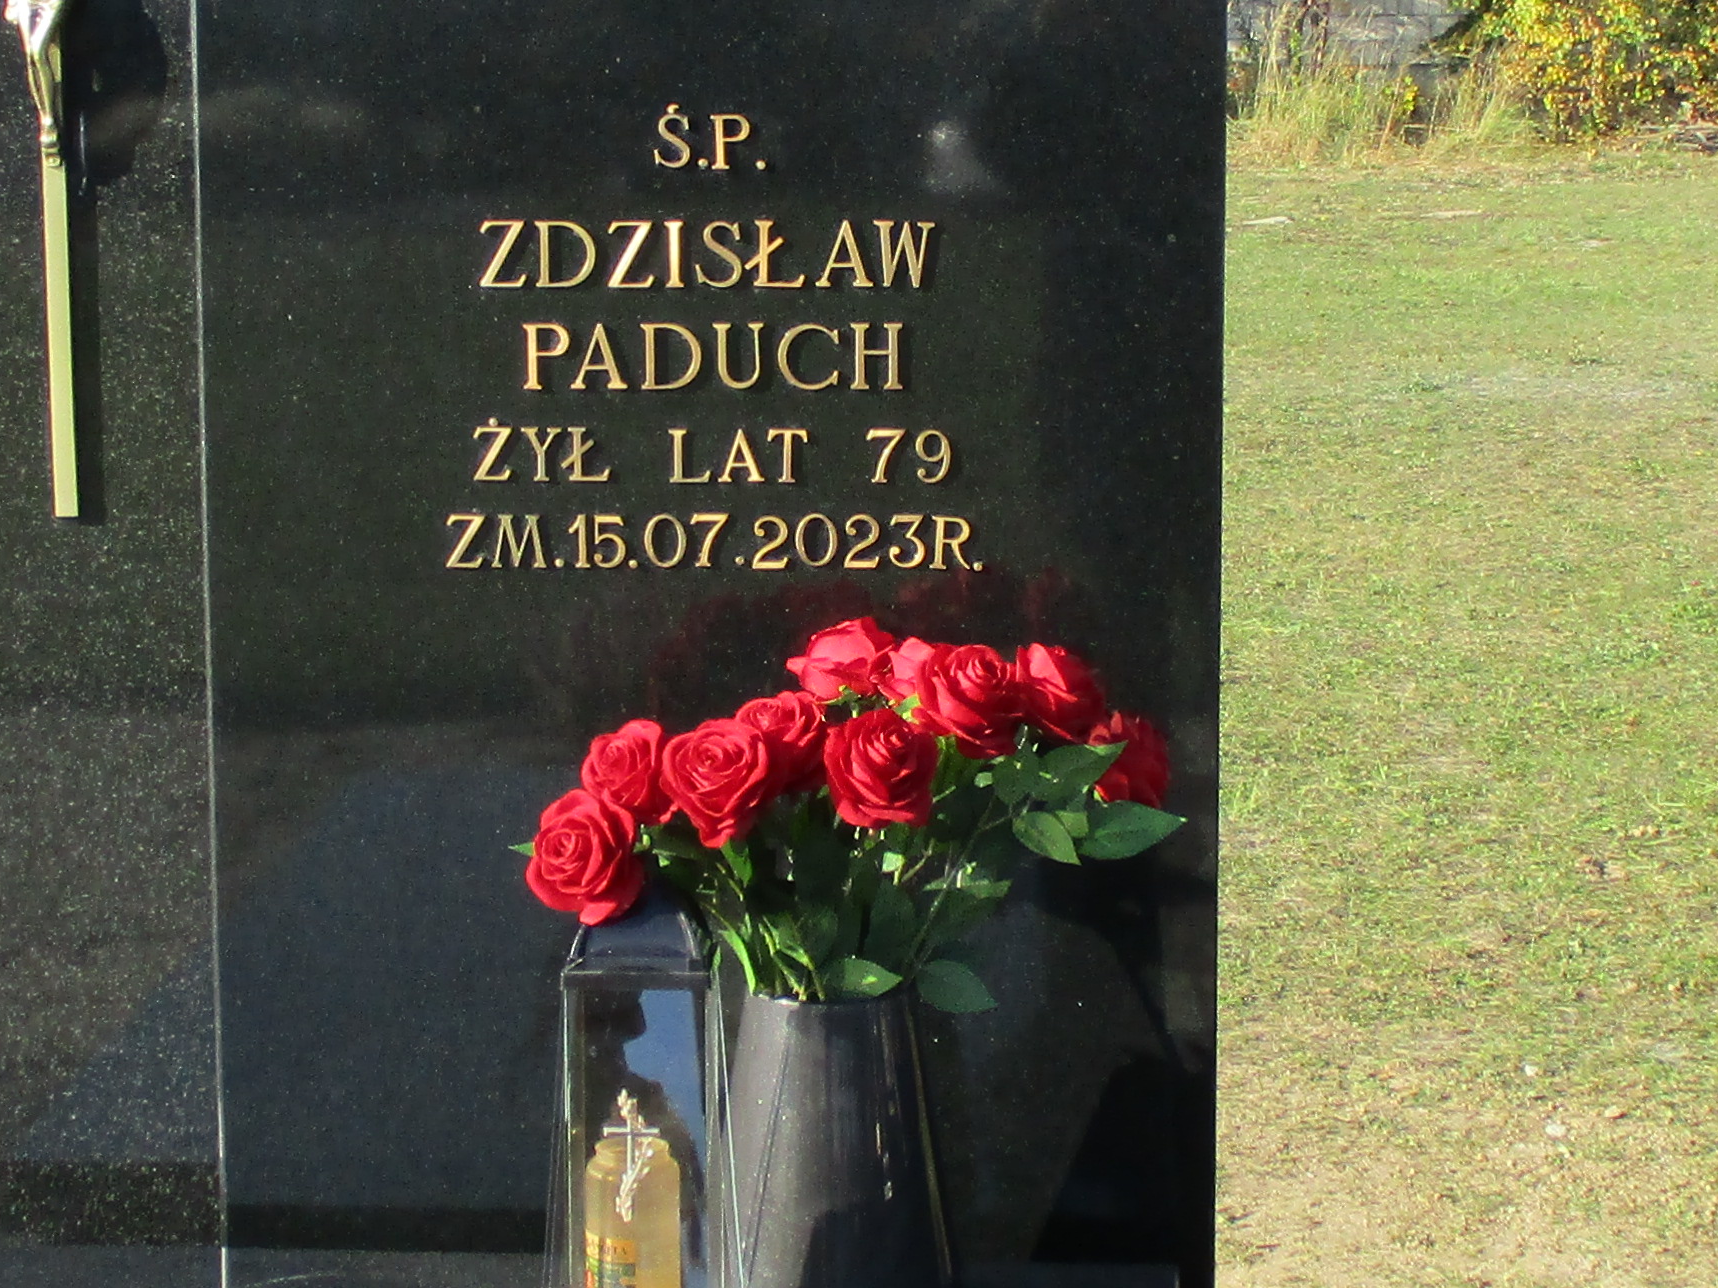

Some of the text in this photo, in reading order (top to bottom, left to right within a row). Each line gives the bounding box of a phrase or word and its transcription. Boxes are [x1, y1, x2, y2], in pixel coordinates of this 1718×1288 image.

[652, 102, 767, 171] Ś.P.
[477, 218, 936, 289] ZDZISŁAW
[521, 321, 904, 392] PADUCH
[471, 416, 953, 484] ŻYŁ LAT 79
[444, 512, 985, 573] ZM.15.07.2023R.
